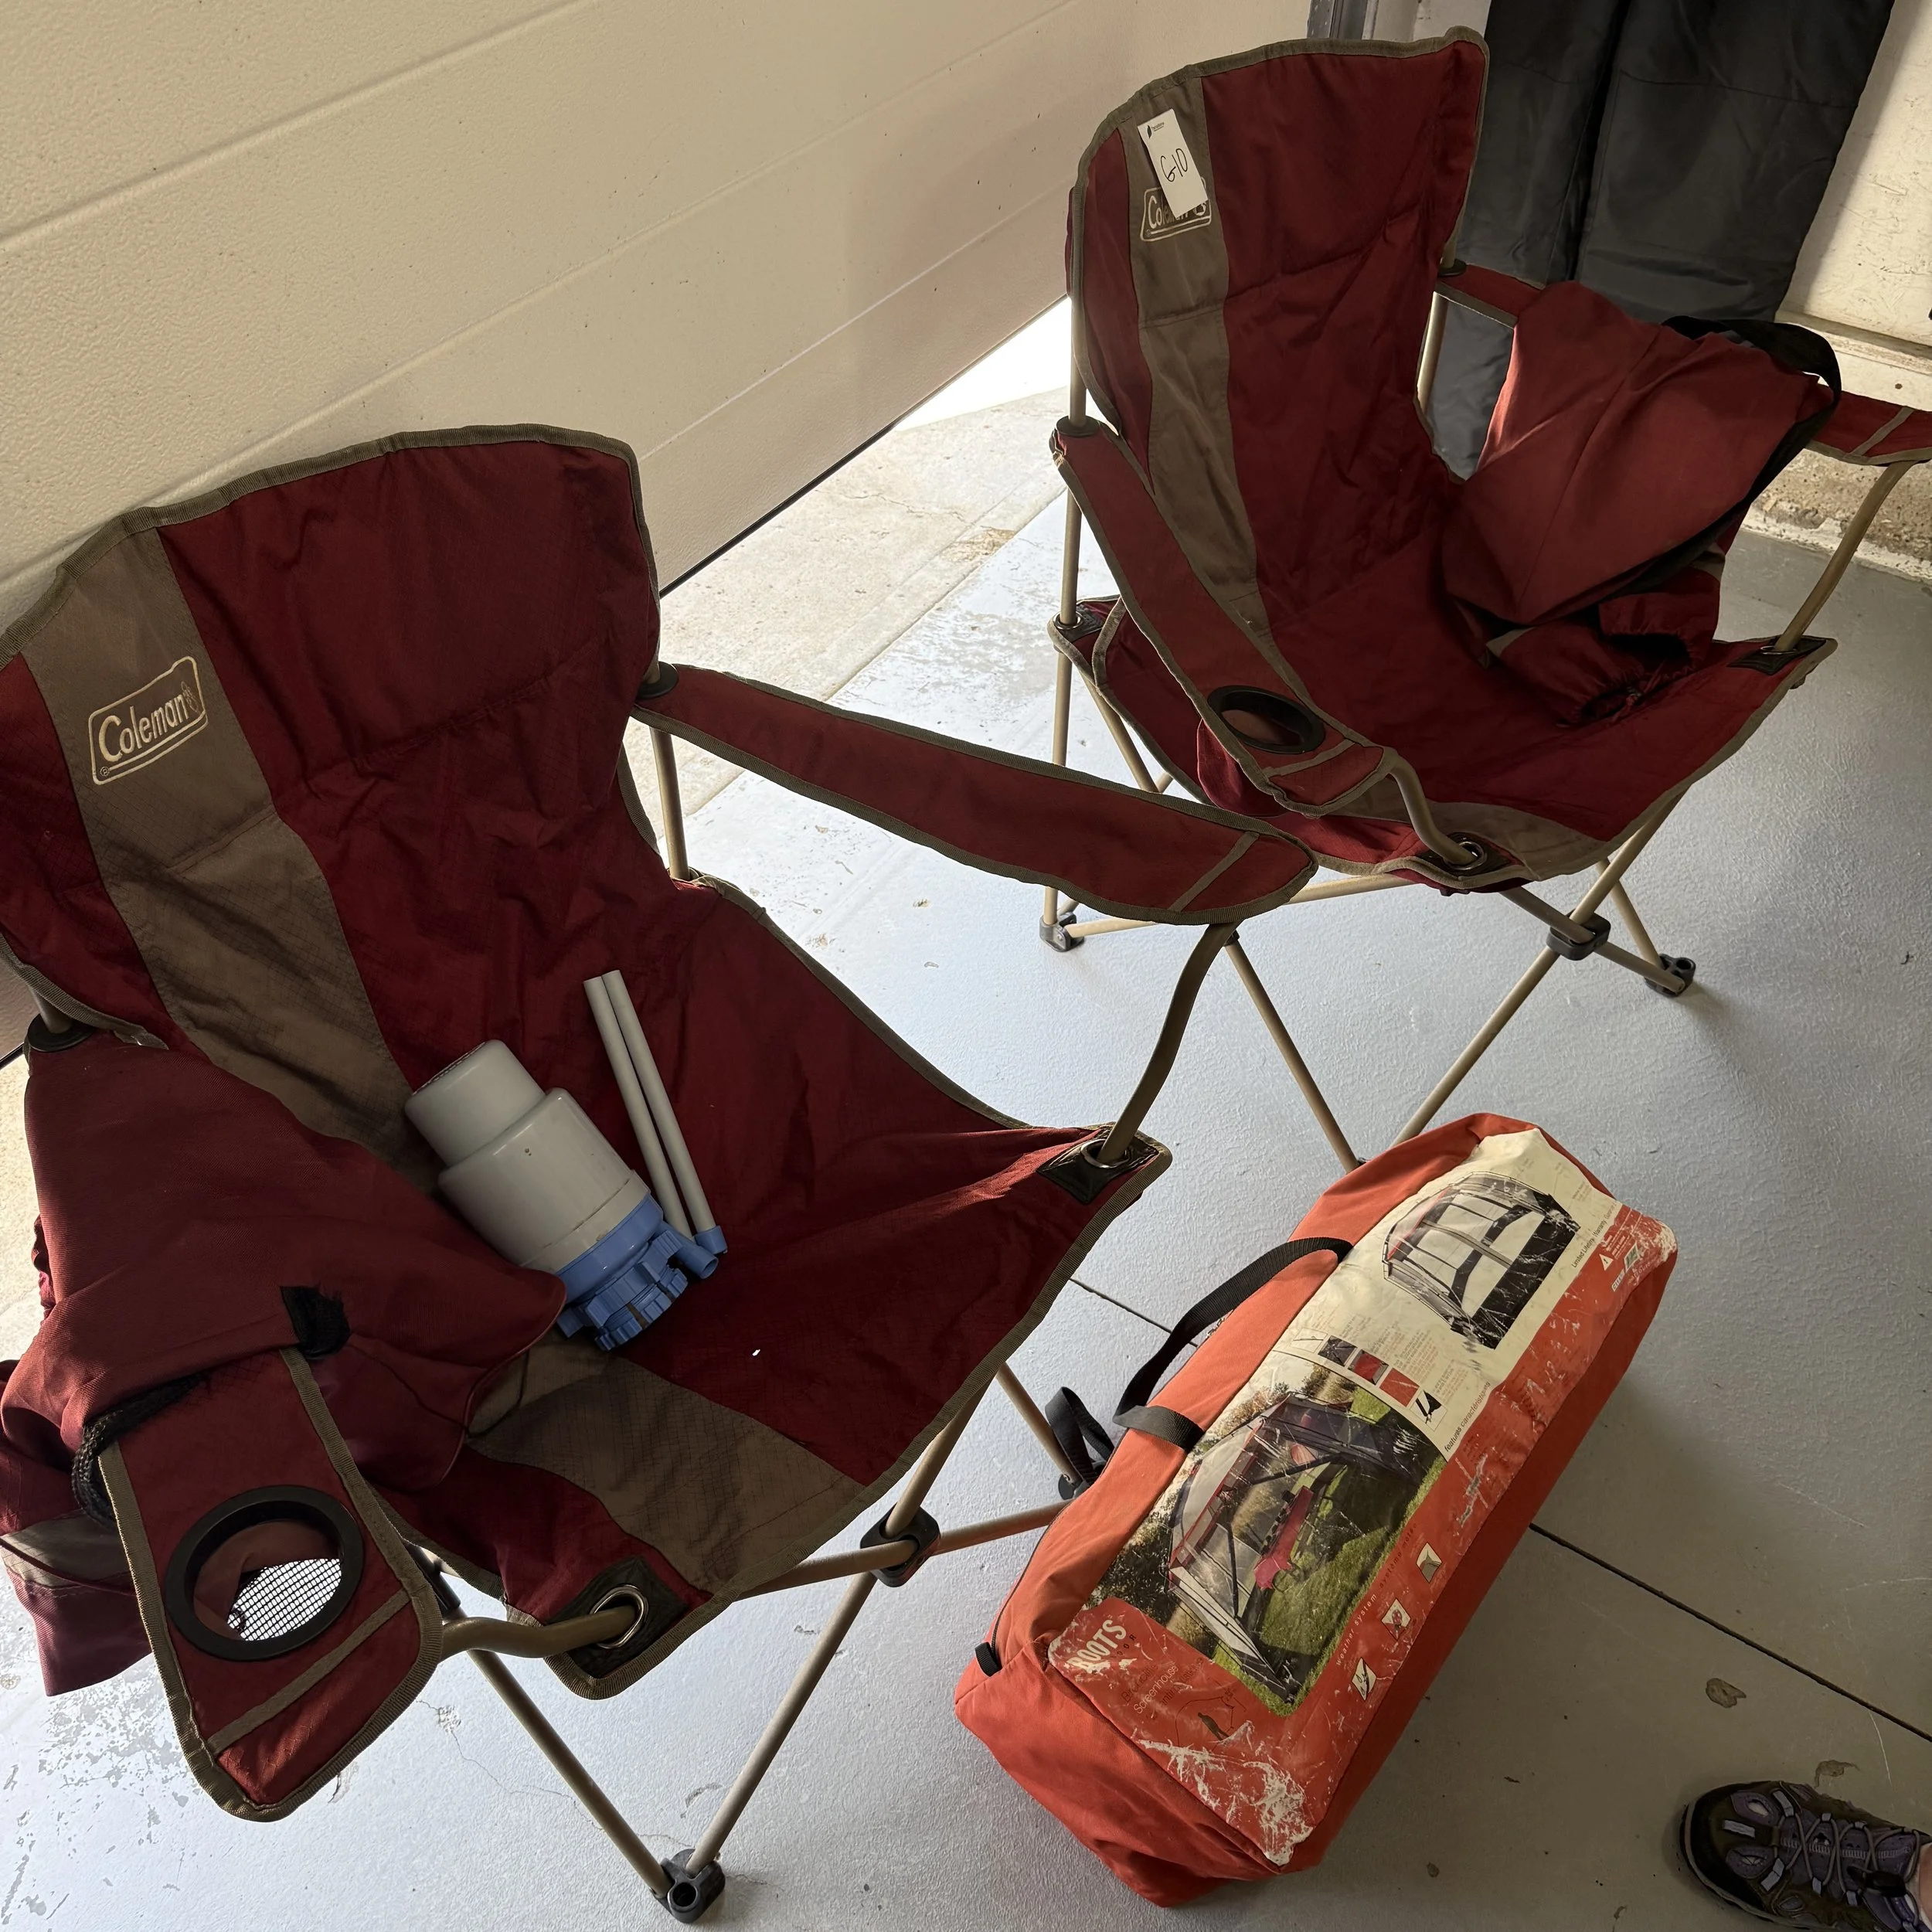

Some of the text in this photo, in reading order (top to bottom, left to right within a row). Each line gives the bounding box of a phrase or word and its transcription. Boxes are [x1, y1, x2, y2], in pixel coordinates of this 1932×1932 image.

[98, 693, 189, 762] Coleman
[1444, 1426, 1462, 1452] features
[1066, 1619, 1127, 1672] ROOTS
[1336, 1628, 1355, 1666] Weather
[1354, 1594, 1377, 1627] system
[1133, 1665, 1179, 1714] Screenhouse
